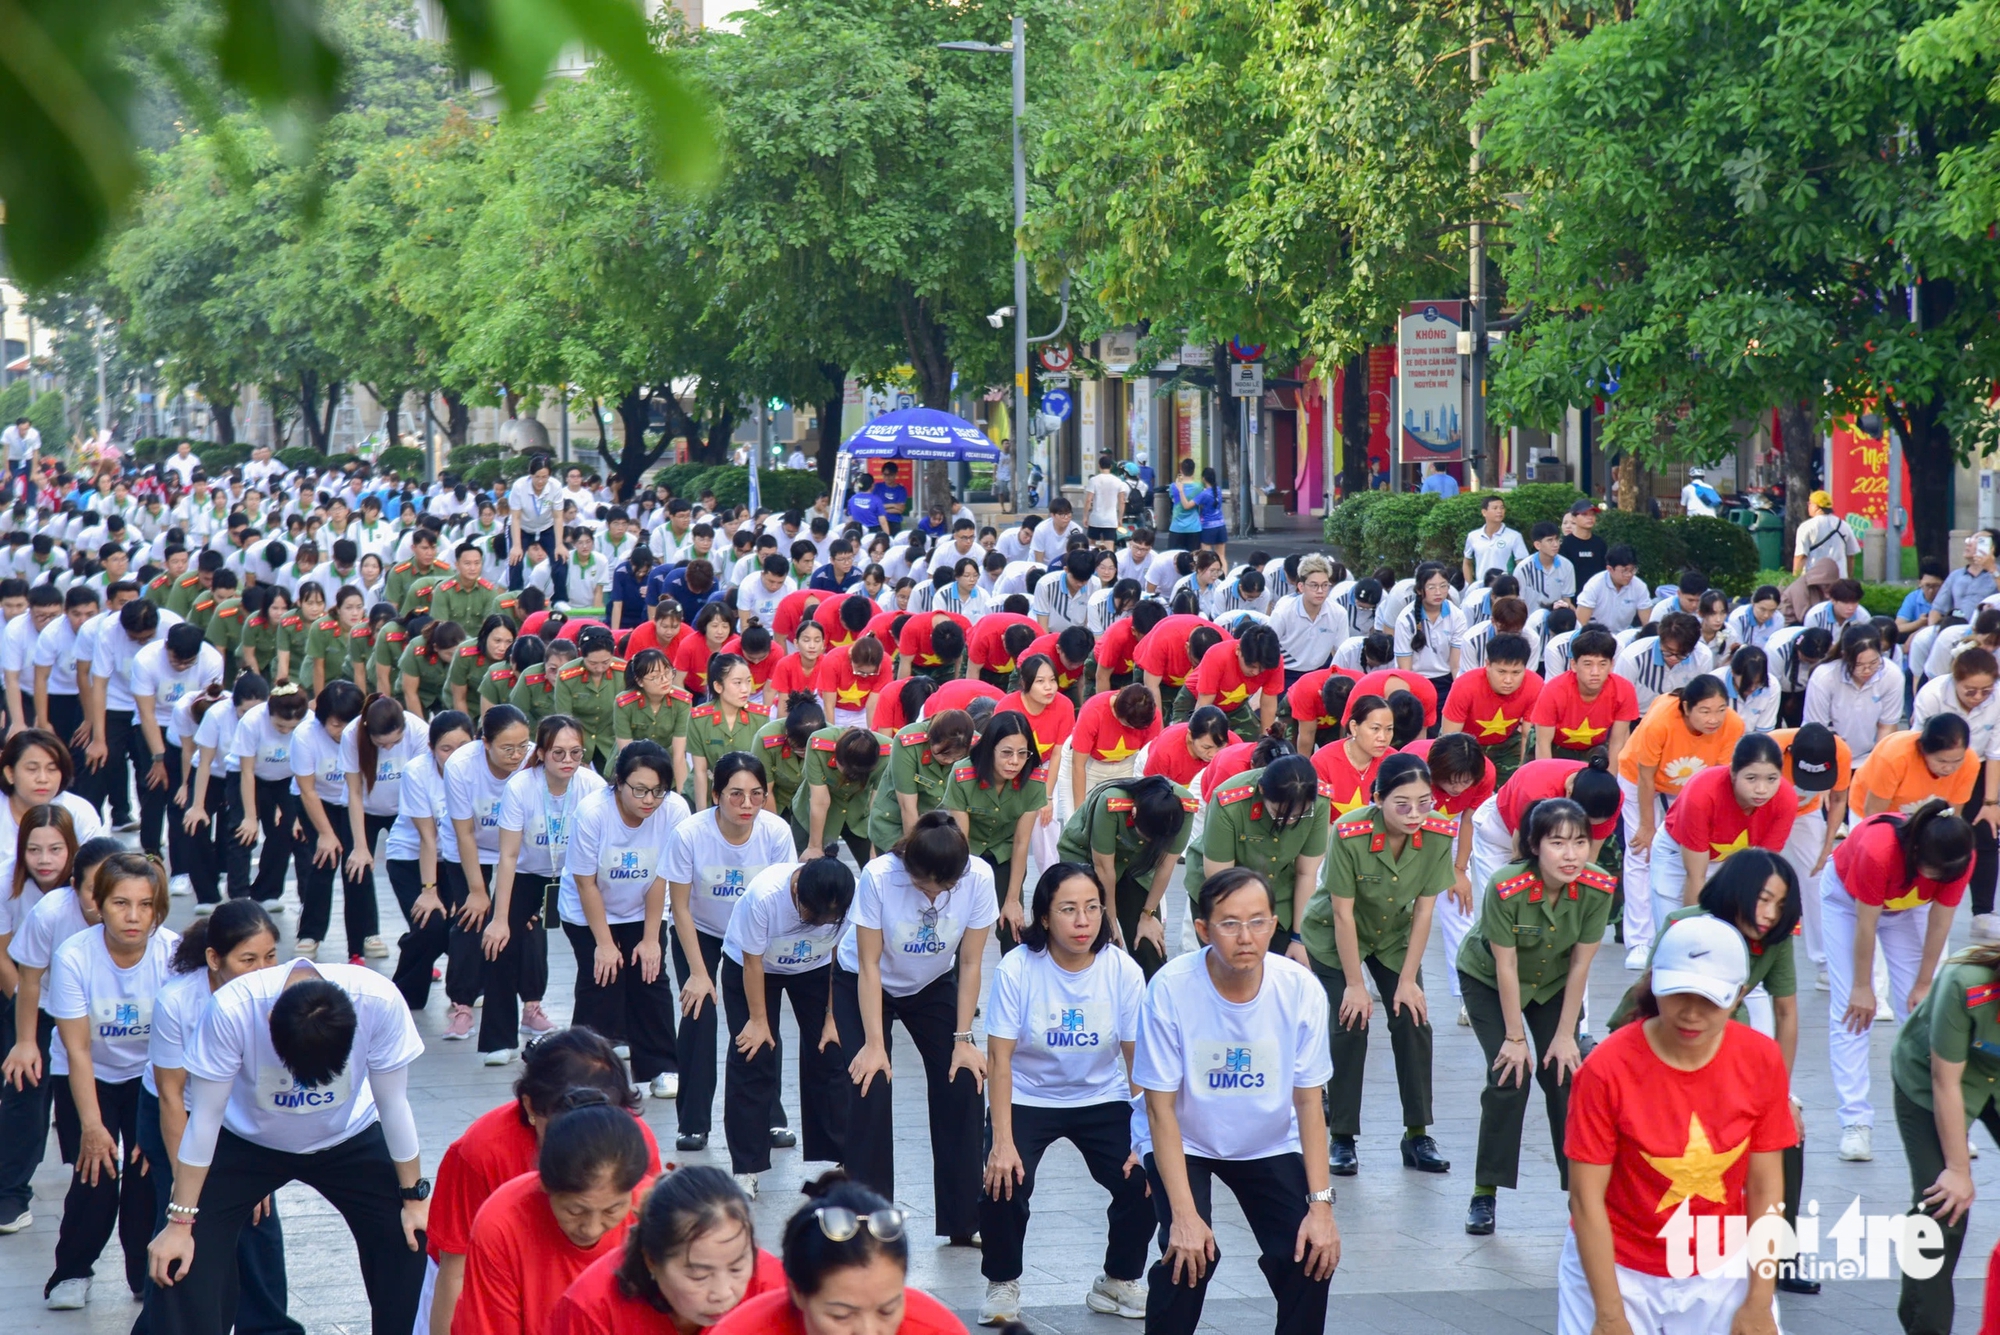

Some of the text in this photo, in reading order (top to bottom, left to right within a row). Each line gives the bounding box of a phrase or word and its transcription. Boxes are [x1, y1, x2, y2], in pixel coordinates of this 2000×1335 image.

[1416, 328, 1446, 339] KHÔNG
[1441, 346, 1457, 355] TRƯỢ
[610, 869, 648, 879] UMC3
[712, 886, 745, 897] UMC
[903, 941, 946, 953] UMC3
[777, 954, 821, 965] UMC3
[1047, 1032, 1099, 1047] UMC3
[1209, 1072, 1265, 1088] UMC3
[274, 1091, 335, 1108] UMC3
